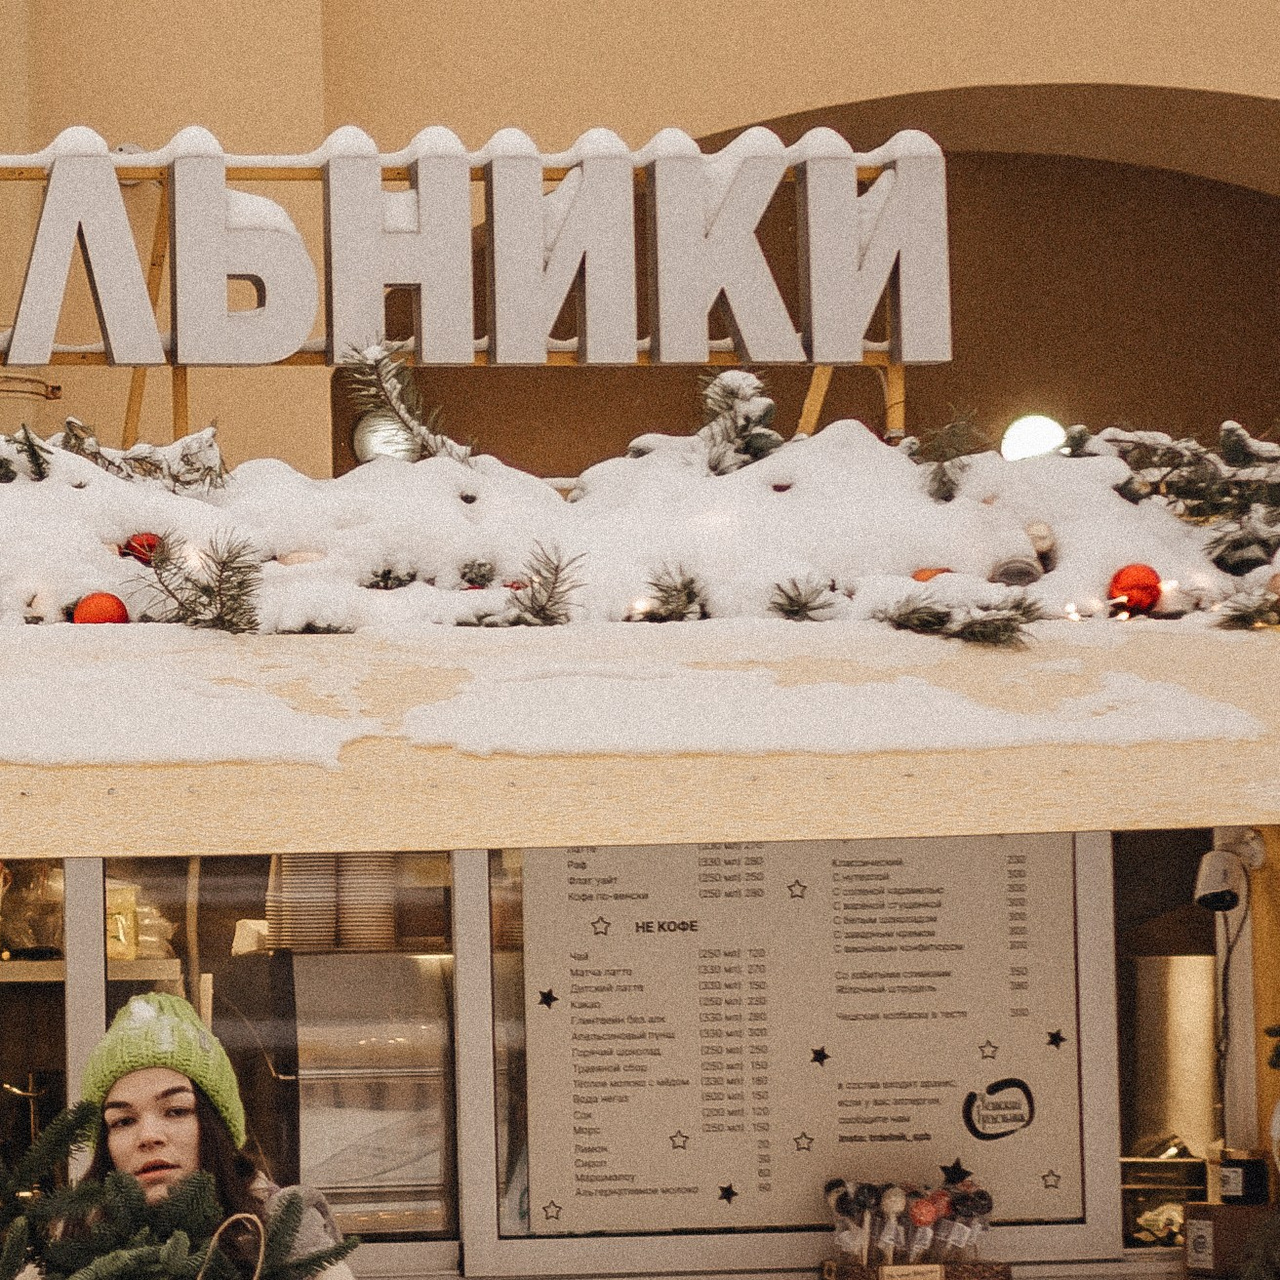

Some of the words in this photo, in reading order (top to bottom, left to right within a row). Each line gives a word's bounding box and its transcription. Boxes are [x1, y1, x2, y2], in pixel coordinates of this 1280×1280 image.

[568, 892, 594, 902] Кофе
[596, 892, 649, 901] по-венски
[635, 921, 654, 933] НЕ
[657, 920, 699, 933] КОФЕ
[569, 951, 589, 961] Чай
[569, 968, 602, 977] Матча
[835, 970, 849, 980] Со
[570, 1001, 601, 1009] Какао
[572, 1032, 646, 1041] Апельсиновый
[648, 1031, 675, 1040] пунш
[571, 1047, 614, 1058] Горячий
[616, 1047, 662, 1057] шоколад
[572, 1064, 621, 1074] Травяной
[622, 1064, 648, 1073] сбор
[609, 1080, 647, 1088] молоко
[572, 1094, 599, 1104] Вода
[573, 1110, 592, 1120] Сок
[573, 1126, 601, 1135] Морс
[574, 1144, 608, 1154] Лимон
[574, 1158, 607, 1168] Сироп
[575, 1187, 659, 1197] Альтернативное
[660, 1186, 699, 1195] молоко
